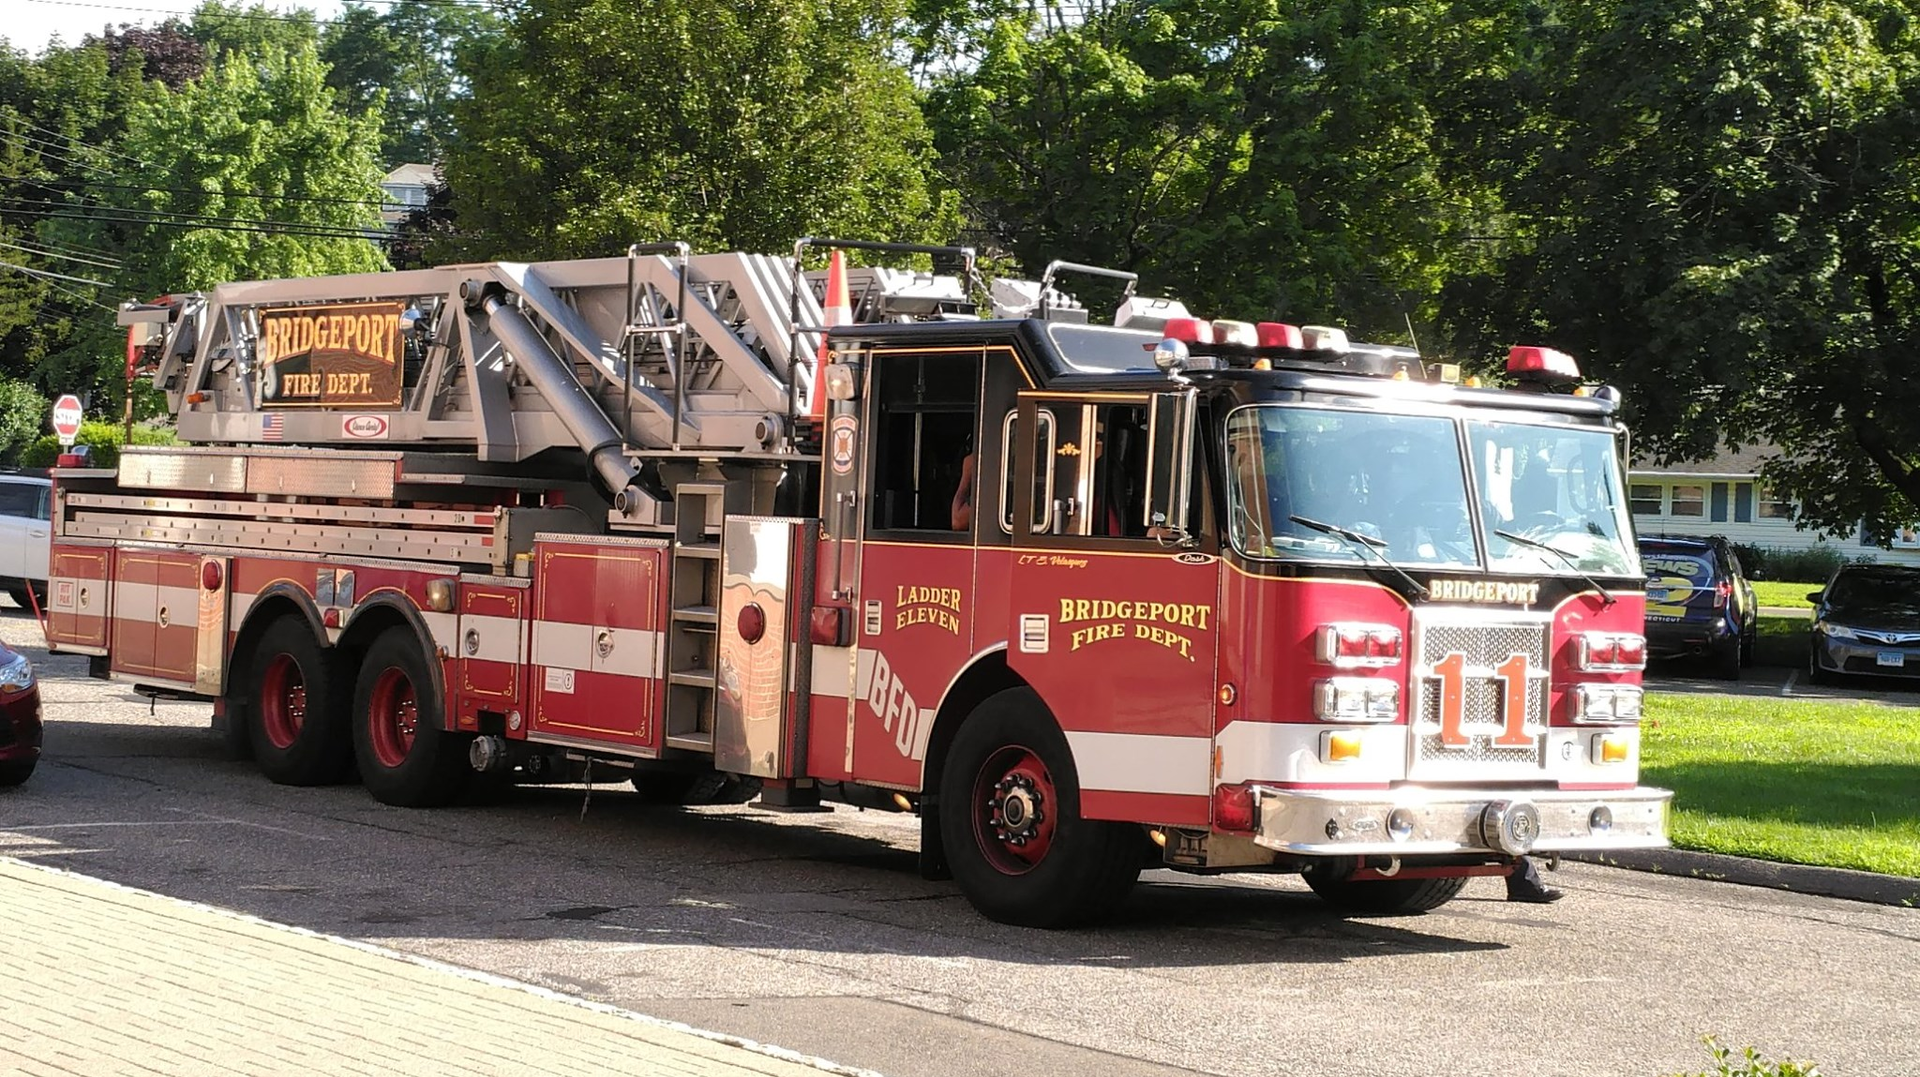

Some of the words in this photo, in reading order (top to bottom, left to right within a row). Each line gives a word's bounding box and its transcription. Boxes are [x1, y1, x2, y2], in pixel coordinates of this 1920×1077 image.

[264, 314, 399, 367] BRIDGEPORT
[282, 374, 321, 397] FIRE
[326, 373, 373, 395] DEPT.
[1183, 554, 1205, 563] Dash
[1641, 560, 1700, 576] EWS
[896, 585, 961, 613] LADDER
[1429, 579, 1540, 605] BRIDGEPORT
[896, 607, 960, 636] ELEVEN
[1059, 598, 1211, 631] BRIDGEPORT
[1071, 623, 1126, 652] FIRE
[1134, 624, 1196, 663] DEPT.
[869, 650, 917, 757] BFD
[1432, 652, 1538, 748] 11
